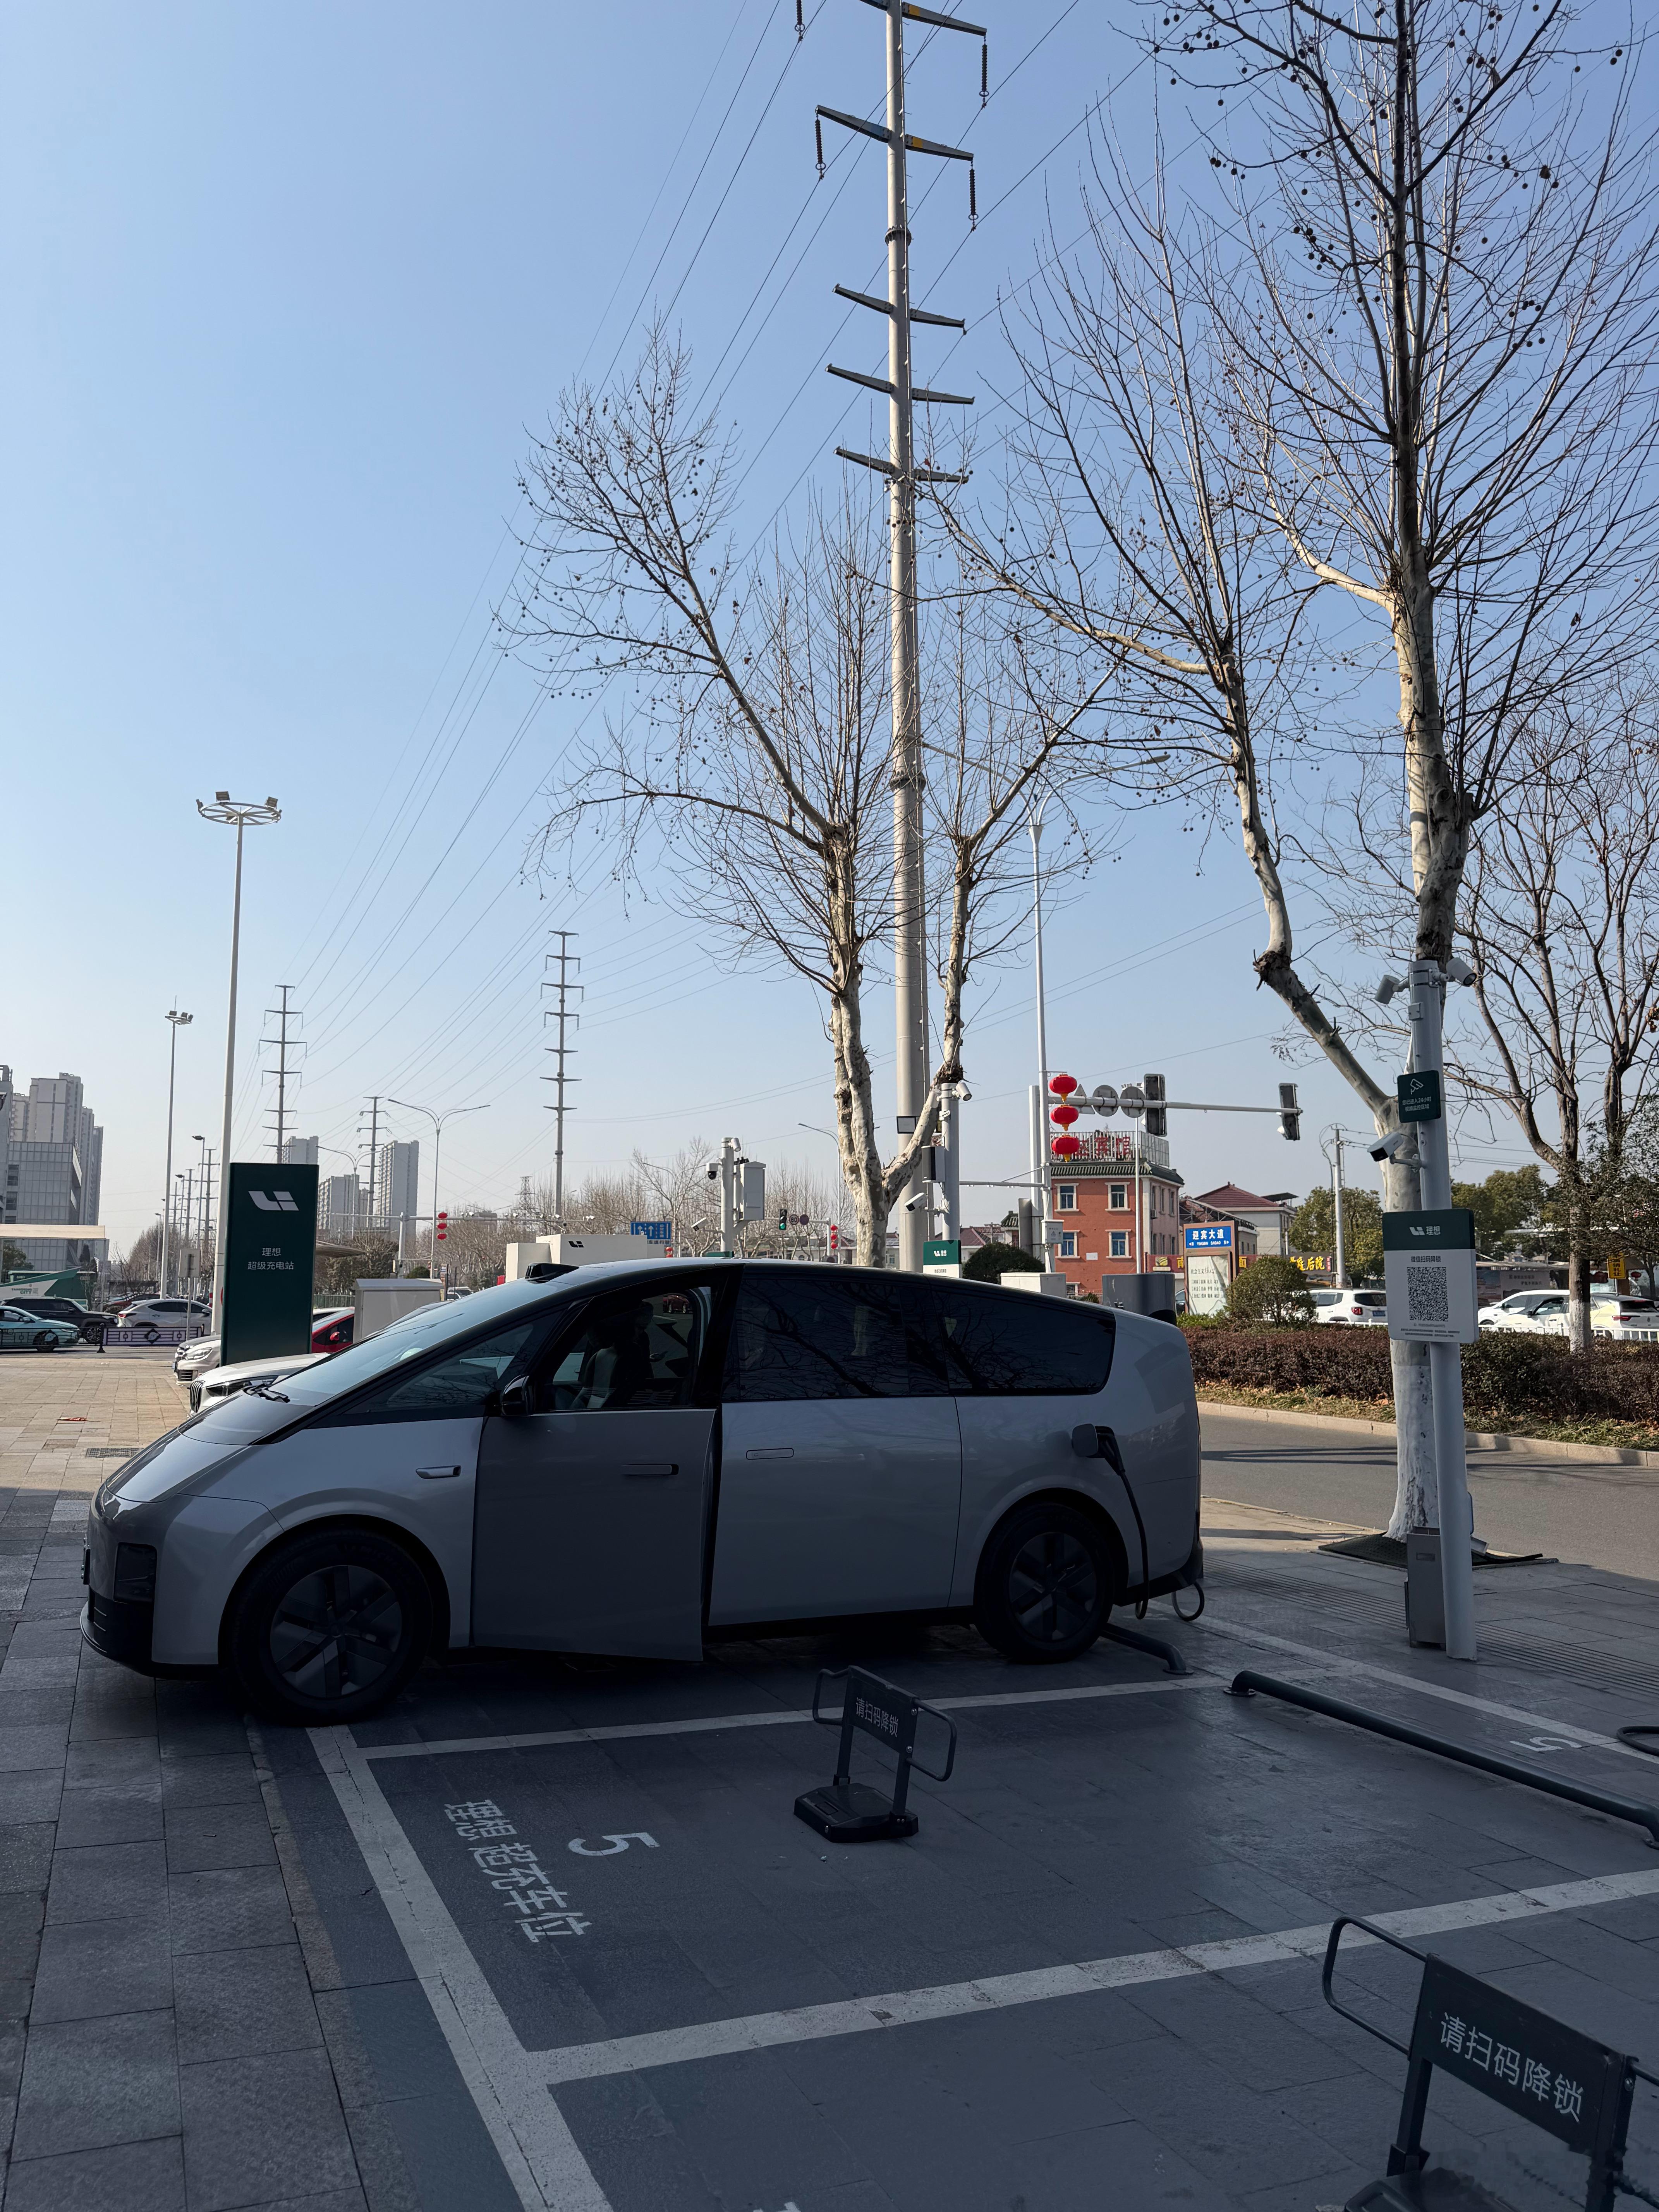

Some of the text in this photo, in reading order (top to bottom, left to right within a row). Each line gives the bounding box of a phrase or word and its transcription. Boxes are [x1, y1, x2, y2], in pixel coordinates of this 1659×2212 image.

[1193, 1229, 1224, 1240] 迎宾大道
[1426, 1226, 1441, 1235] 理想
[262, 1247, 281, 1257] 理想
[247, 1261, 294, 1270] 超级充电站
[1290, 1256, 1325, 1271] 庭后院
[856, 1697, 899, 1738] 请扫码降锁
[568, 1832, 660, 1856] 5
[444, 1799, 592, 1942] 理想超充车位
[1439, 2012, 1584, 2123] 请扫码降锁
